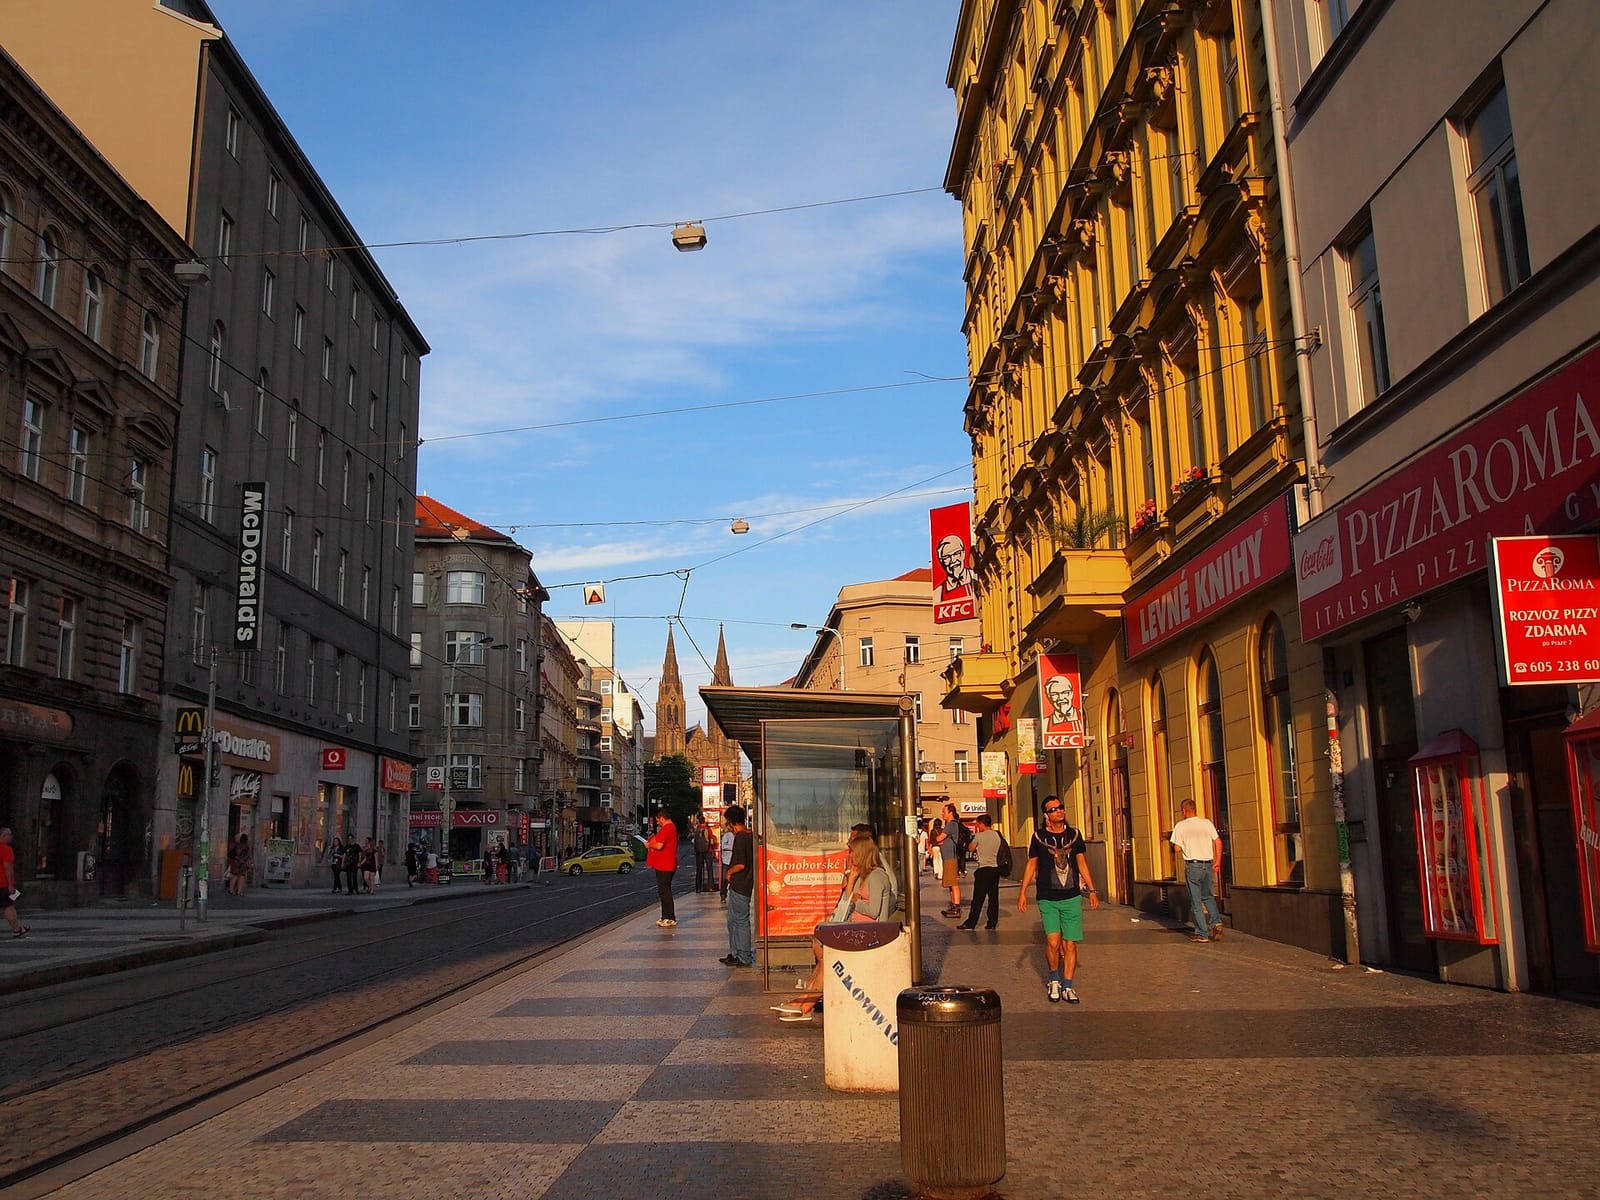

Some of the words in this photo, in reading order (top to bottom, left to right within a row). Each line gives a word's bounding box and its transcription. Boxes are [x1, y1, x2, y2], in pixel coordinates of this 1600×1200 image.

[237, 491, 262, 641] McDonald's
[1140, 570, 1191, 645] LEVNÉ
[1194, 528, 1263, 613] KNIHY
[1314, 571, 1399, 629] ITALSKÁ
[1417, 534, 1487, 586] PIZZ
[938, 603, 971, 618] KFC
[1510, 610, 1560, 621] ROZVOZ
[1564, 608, 1598, 620] PIZZY
[1524, 624, 1587, 638] ZDARMA
[1530, 661, 1553, 673] 605
[1557, 660, 1580, 671] 238
[1046, 735, 1080, 746] KFC
[460, 813, 497, 824] VAIO
[1580, 824, 1600, 851] GRIL
[767, 858, 840, 874] Kutnohorské
